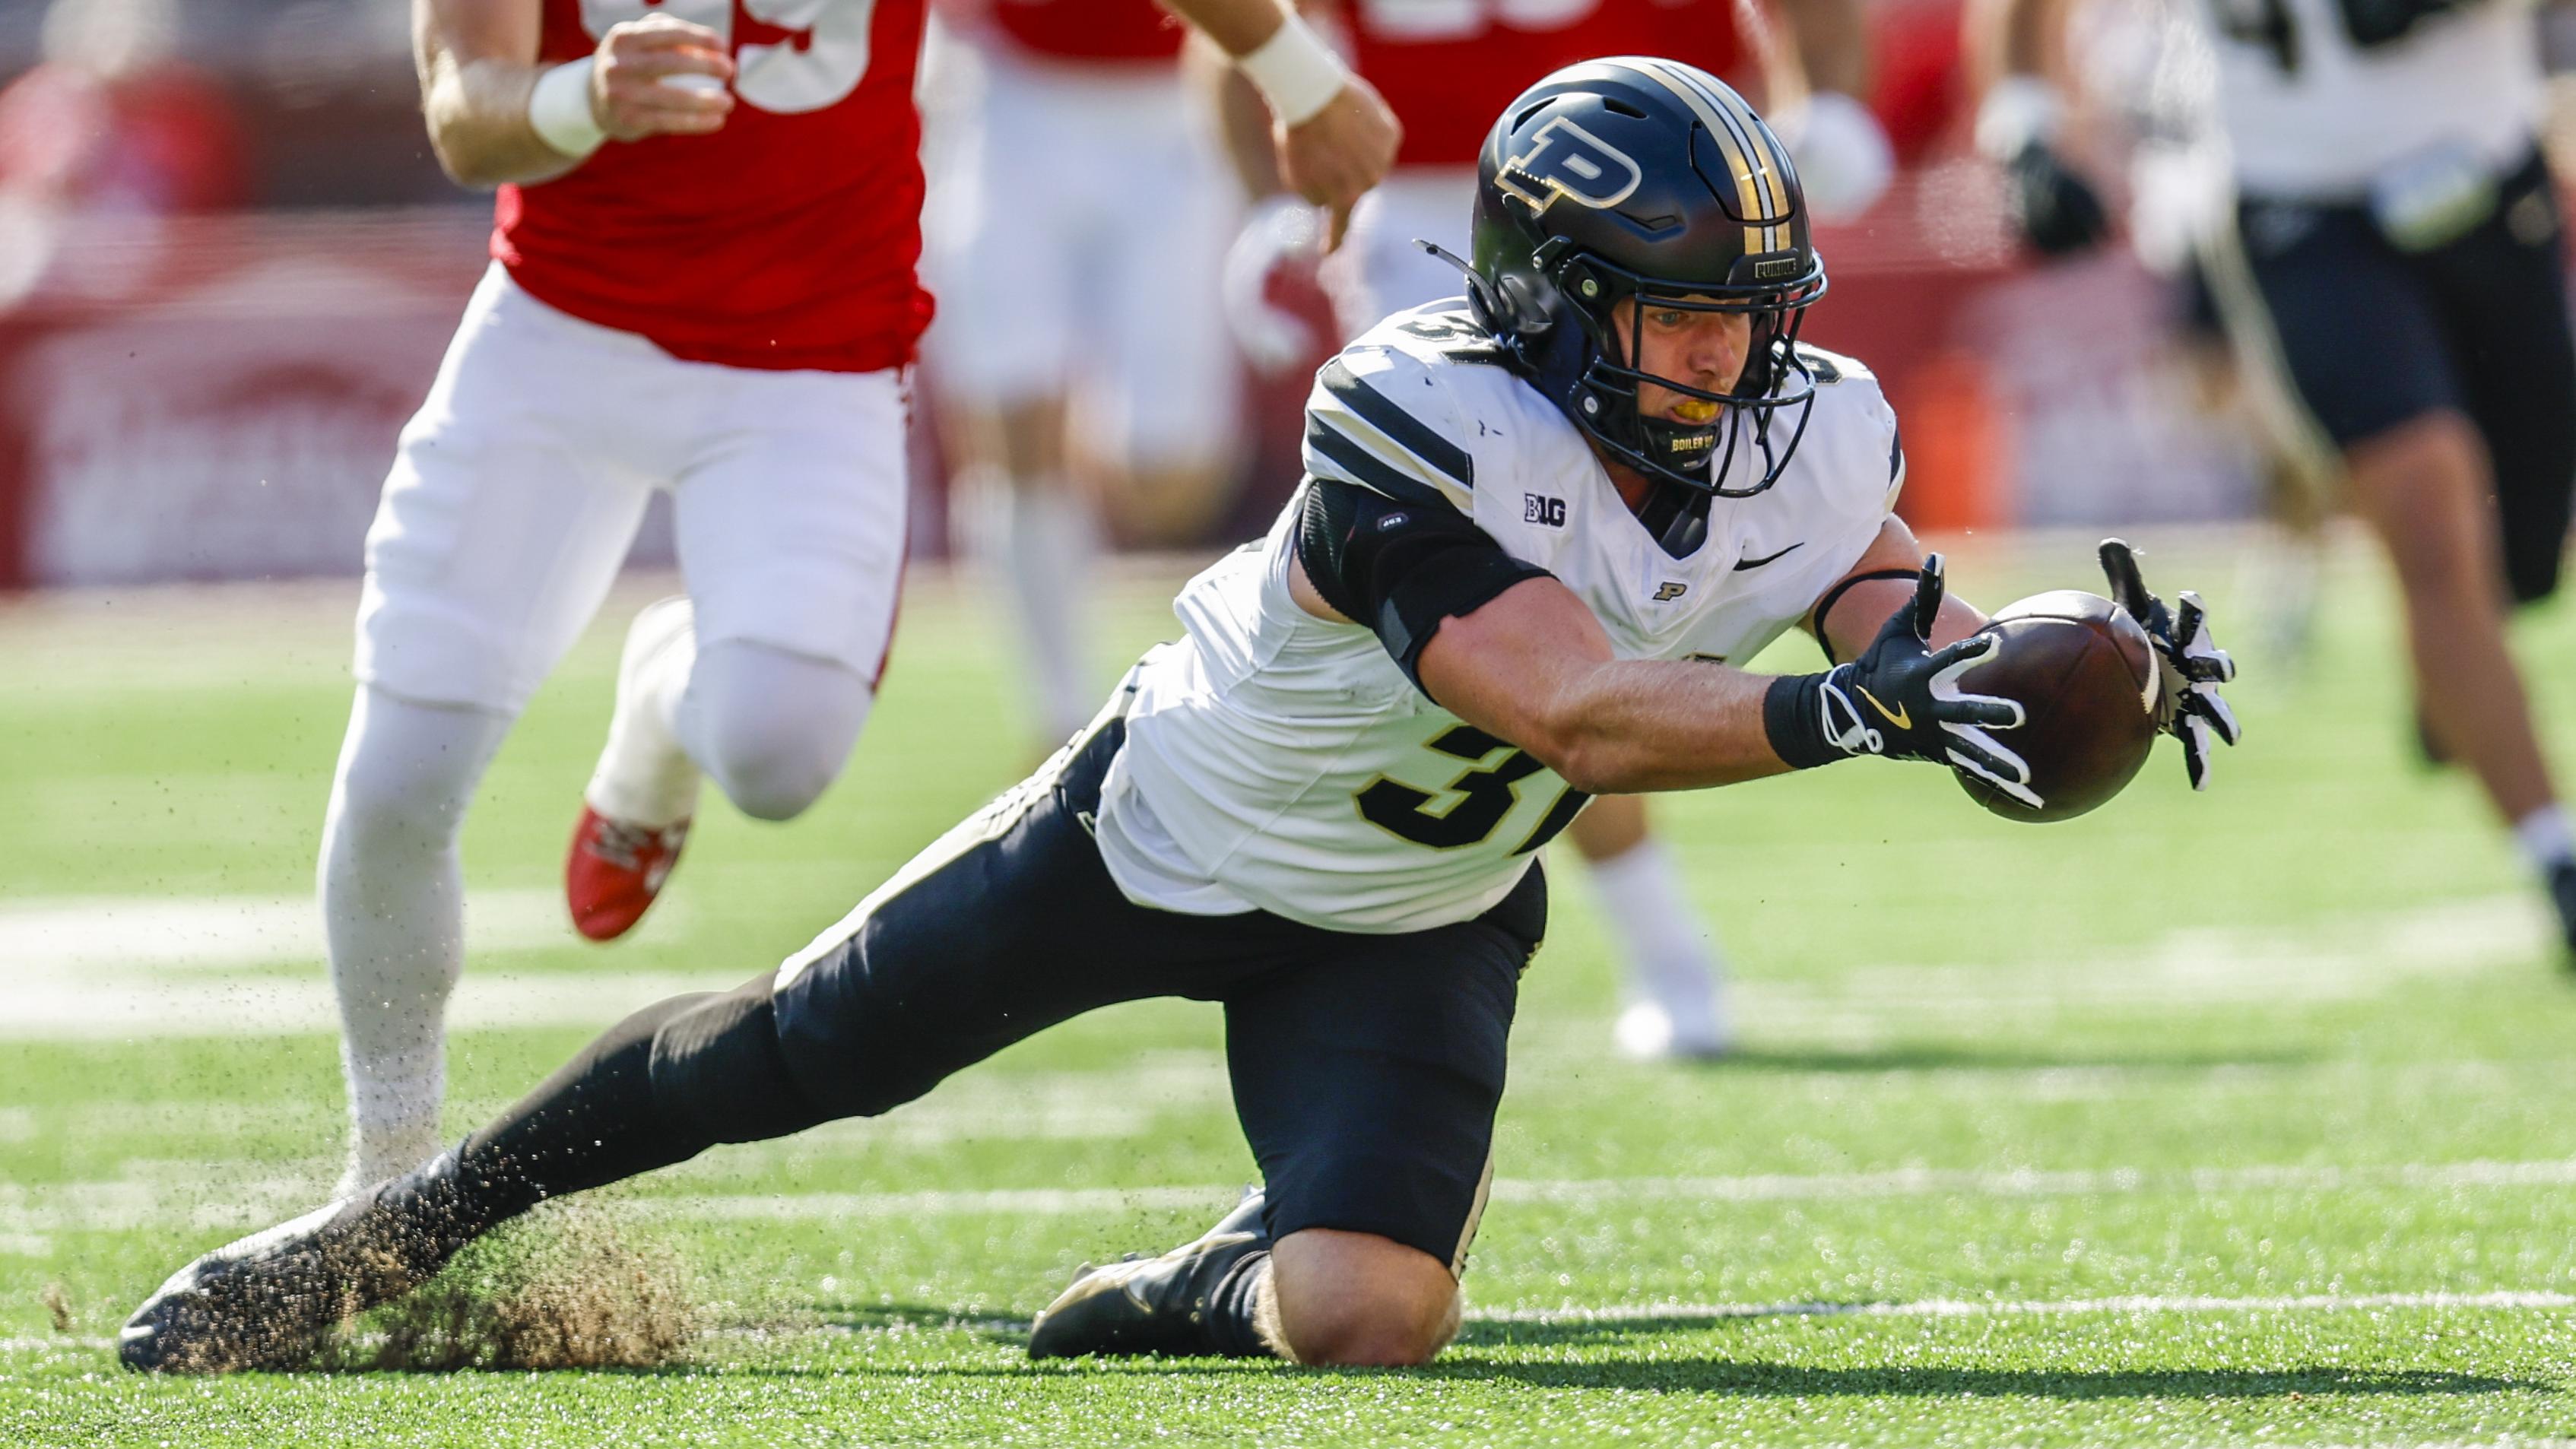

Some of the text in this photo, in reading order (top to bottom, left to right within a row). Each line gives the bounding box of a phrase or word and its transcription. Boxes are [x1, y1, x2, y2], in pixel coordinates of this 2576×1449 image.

[1494, 116, 1642, 217] P
[1755, 257, 1797, 279] PURDUE
[1671, 436, 1704, 452] BOILER
[1652, 581, 1687, 601] P
